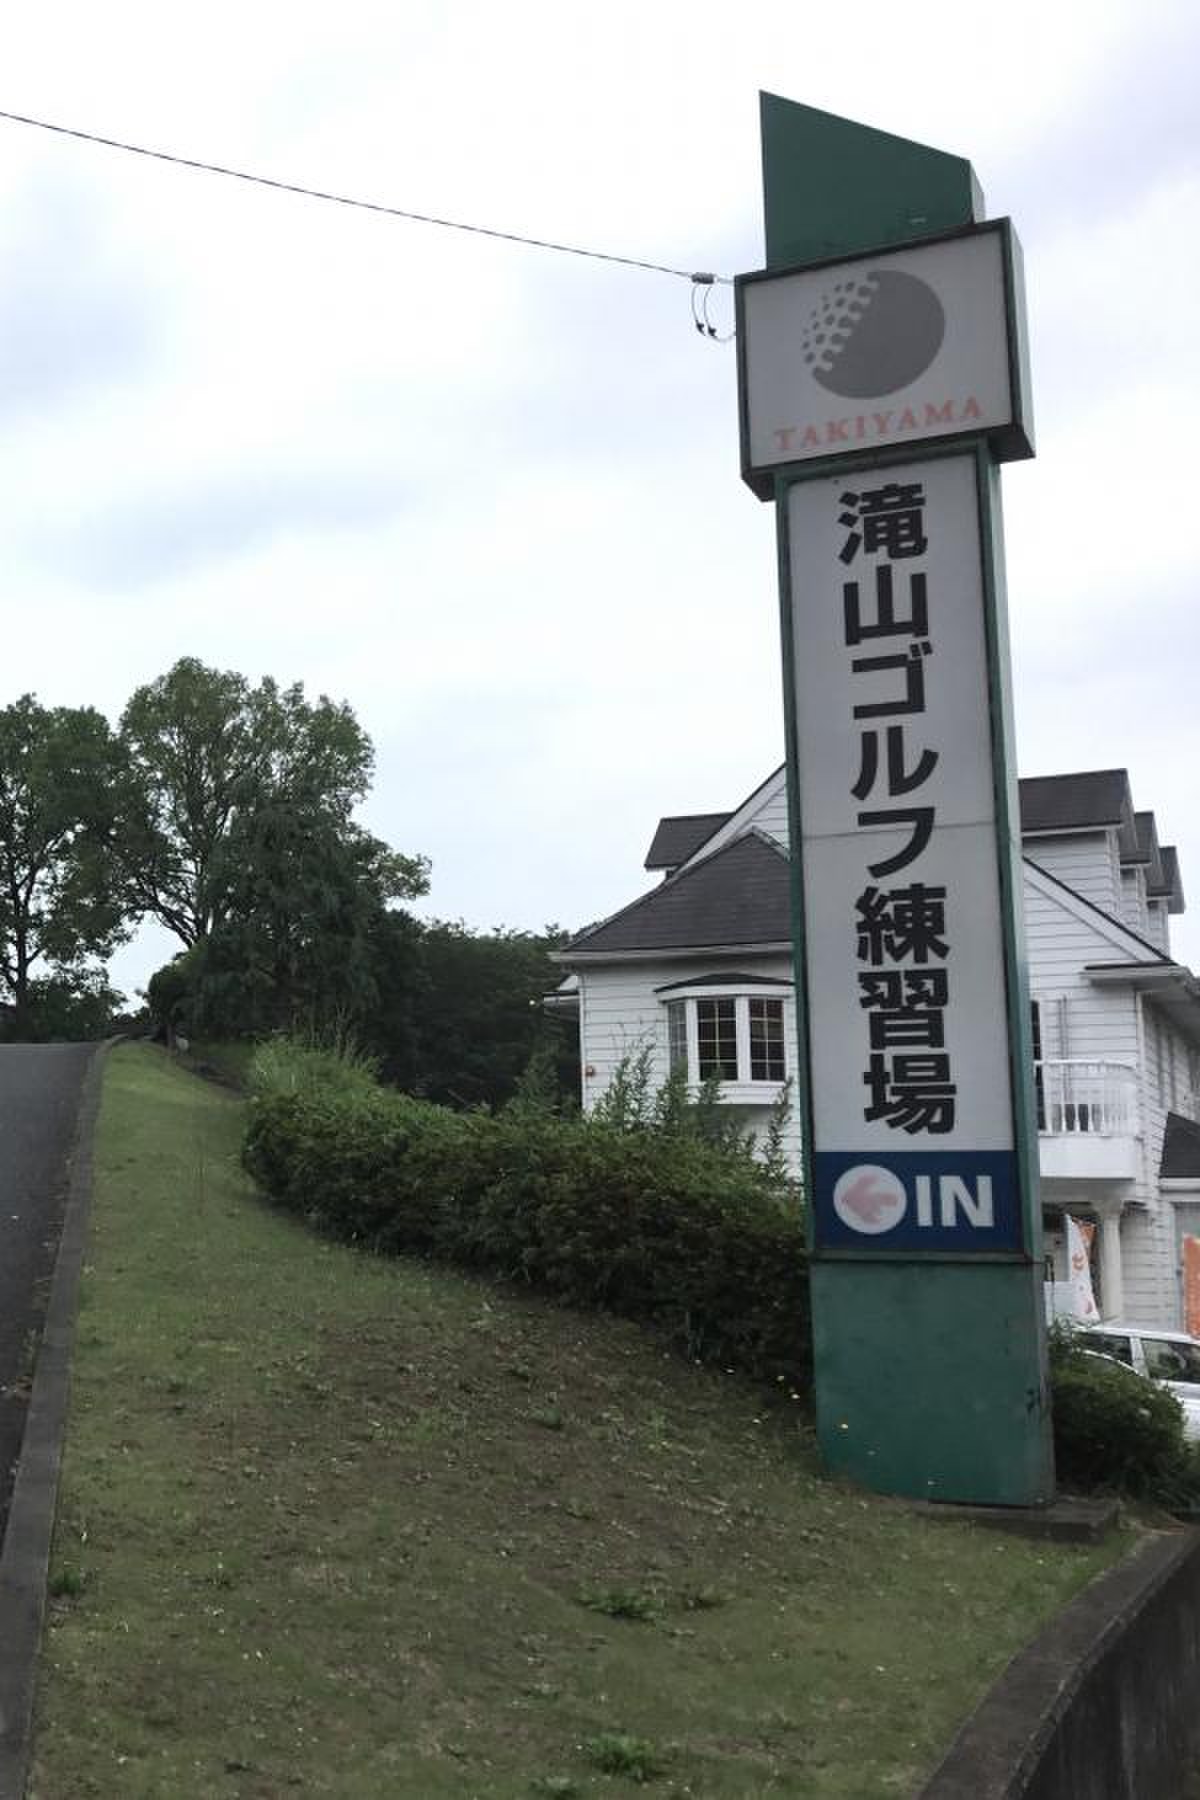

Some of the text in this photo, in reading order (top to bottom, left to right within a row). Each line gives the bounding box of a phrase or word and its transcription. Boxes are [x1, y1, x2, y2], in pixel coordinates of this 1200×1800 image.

[775, 396, 984, 451] TAKIYAMA
[837, 483, 957, 1135] 滝山ゴルフ練習場
[914, 1175, 994, 1227] IN
